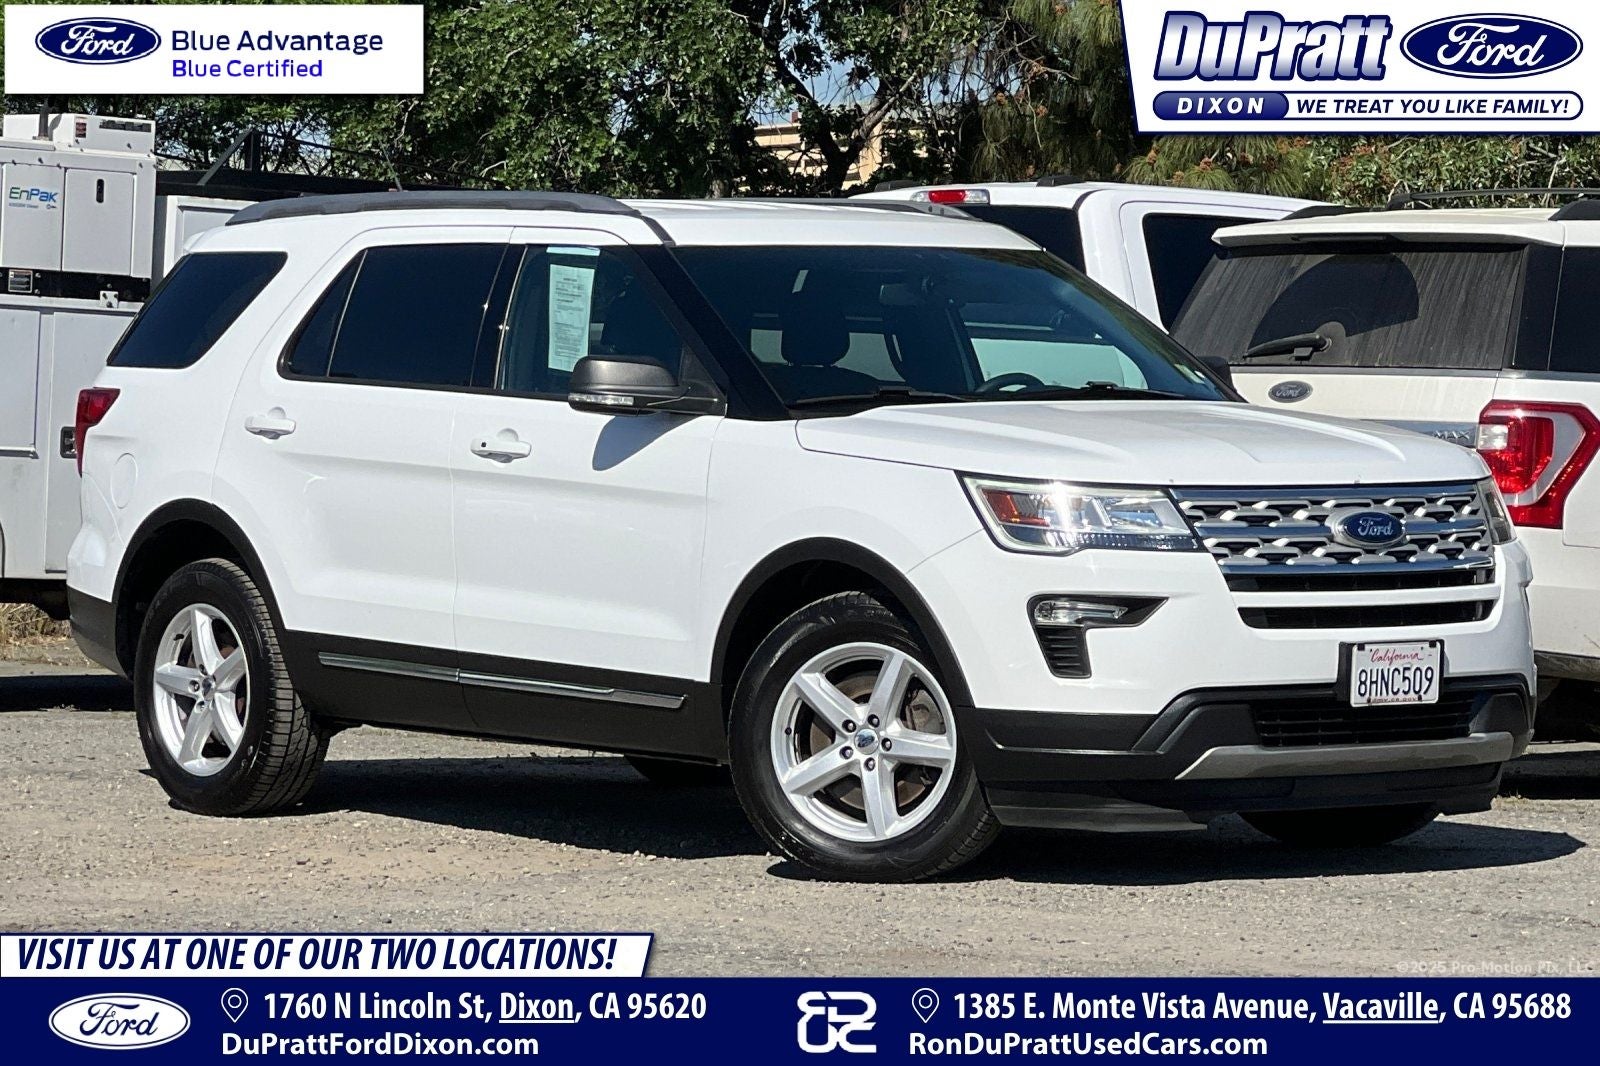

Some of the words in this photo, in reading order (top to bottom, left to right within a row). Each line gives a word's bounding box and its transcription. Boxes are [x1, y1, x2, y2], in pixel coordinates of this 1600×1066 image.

[9, 186, 58, 203] EnPak
[1357, 517, 1394, 536] Ford
[1370, 648, 1424, 666] California
[1357, 666, 1434, 697] 8HNC509
